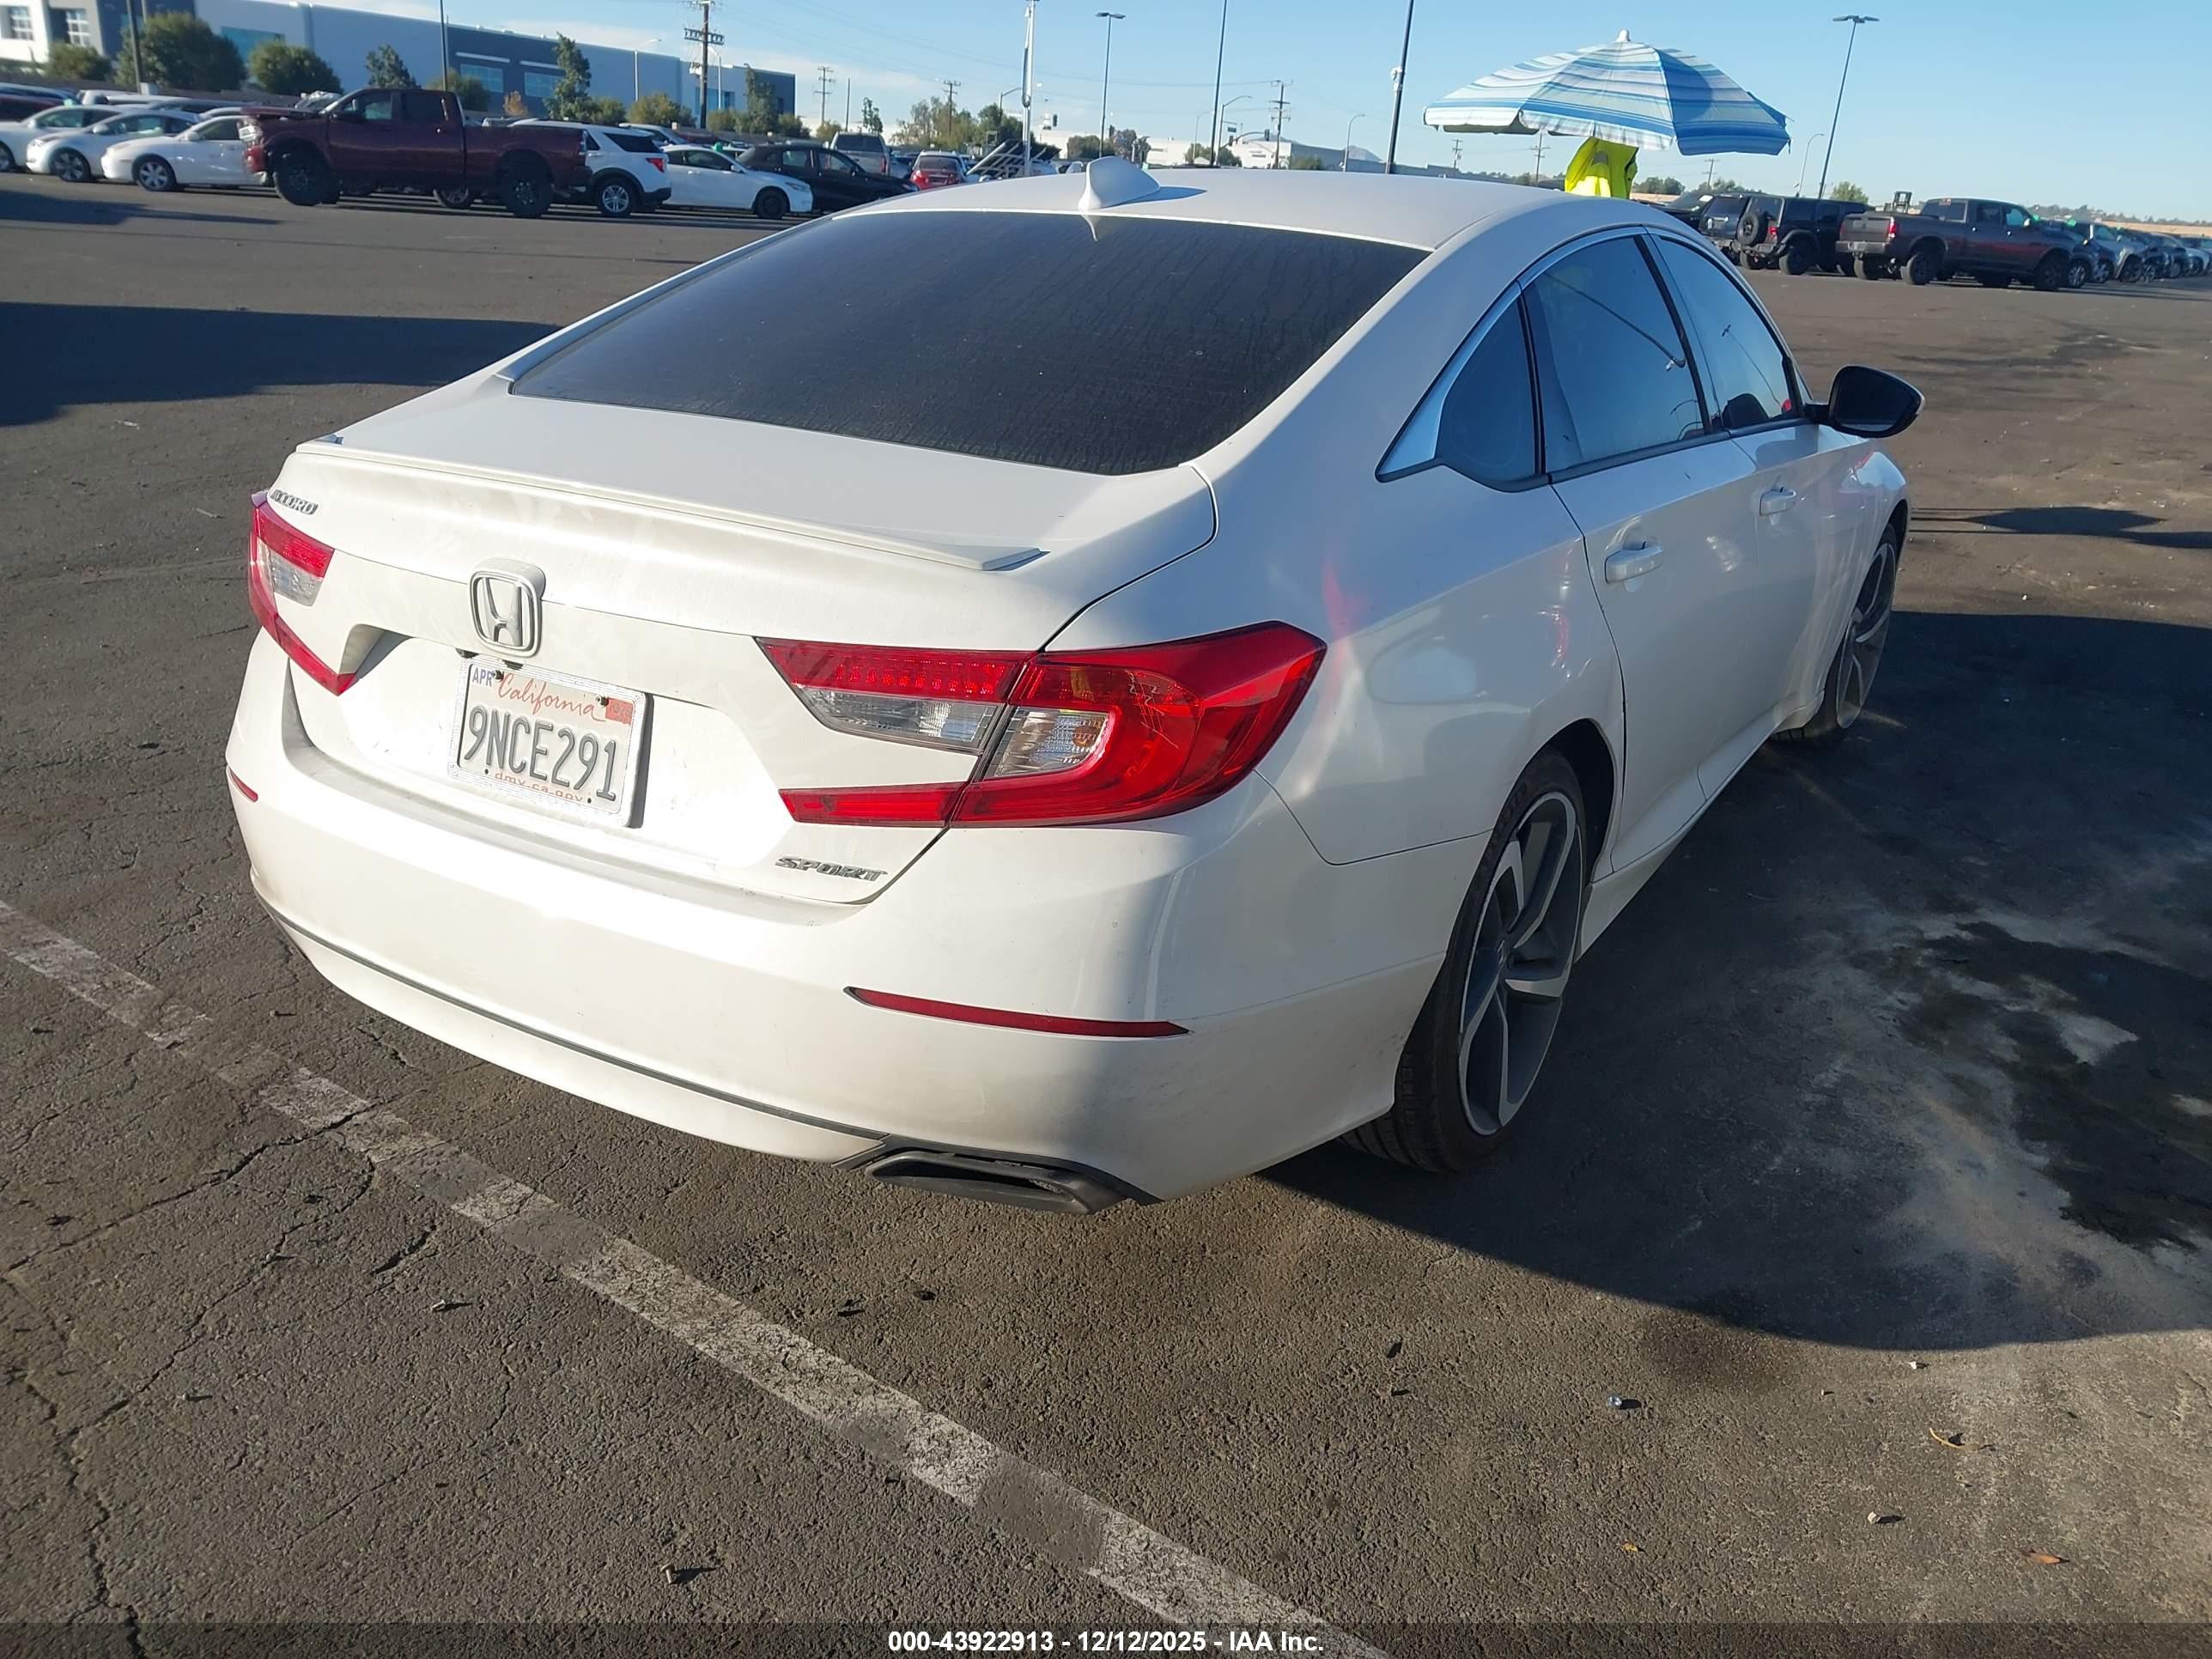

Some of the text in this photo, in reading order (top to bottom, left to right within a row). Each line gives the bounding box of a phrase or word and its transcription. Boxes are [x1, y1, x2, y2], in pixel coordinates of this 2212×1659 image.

[472, 667, 493, 687] APR
[497, 673, 606, 722] California
[464, 705, 617, 802] 9NCE291
[775, 858, 888, 882] SPORT
